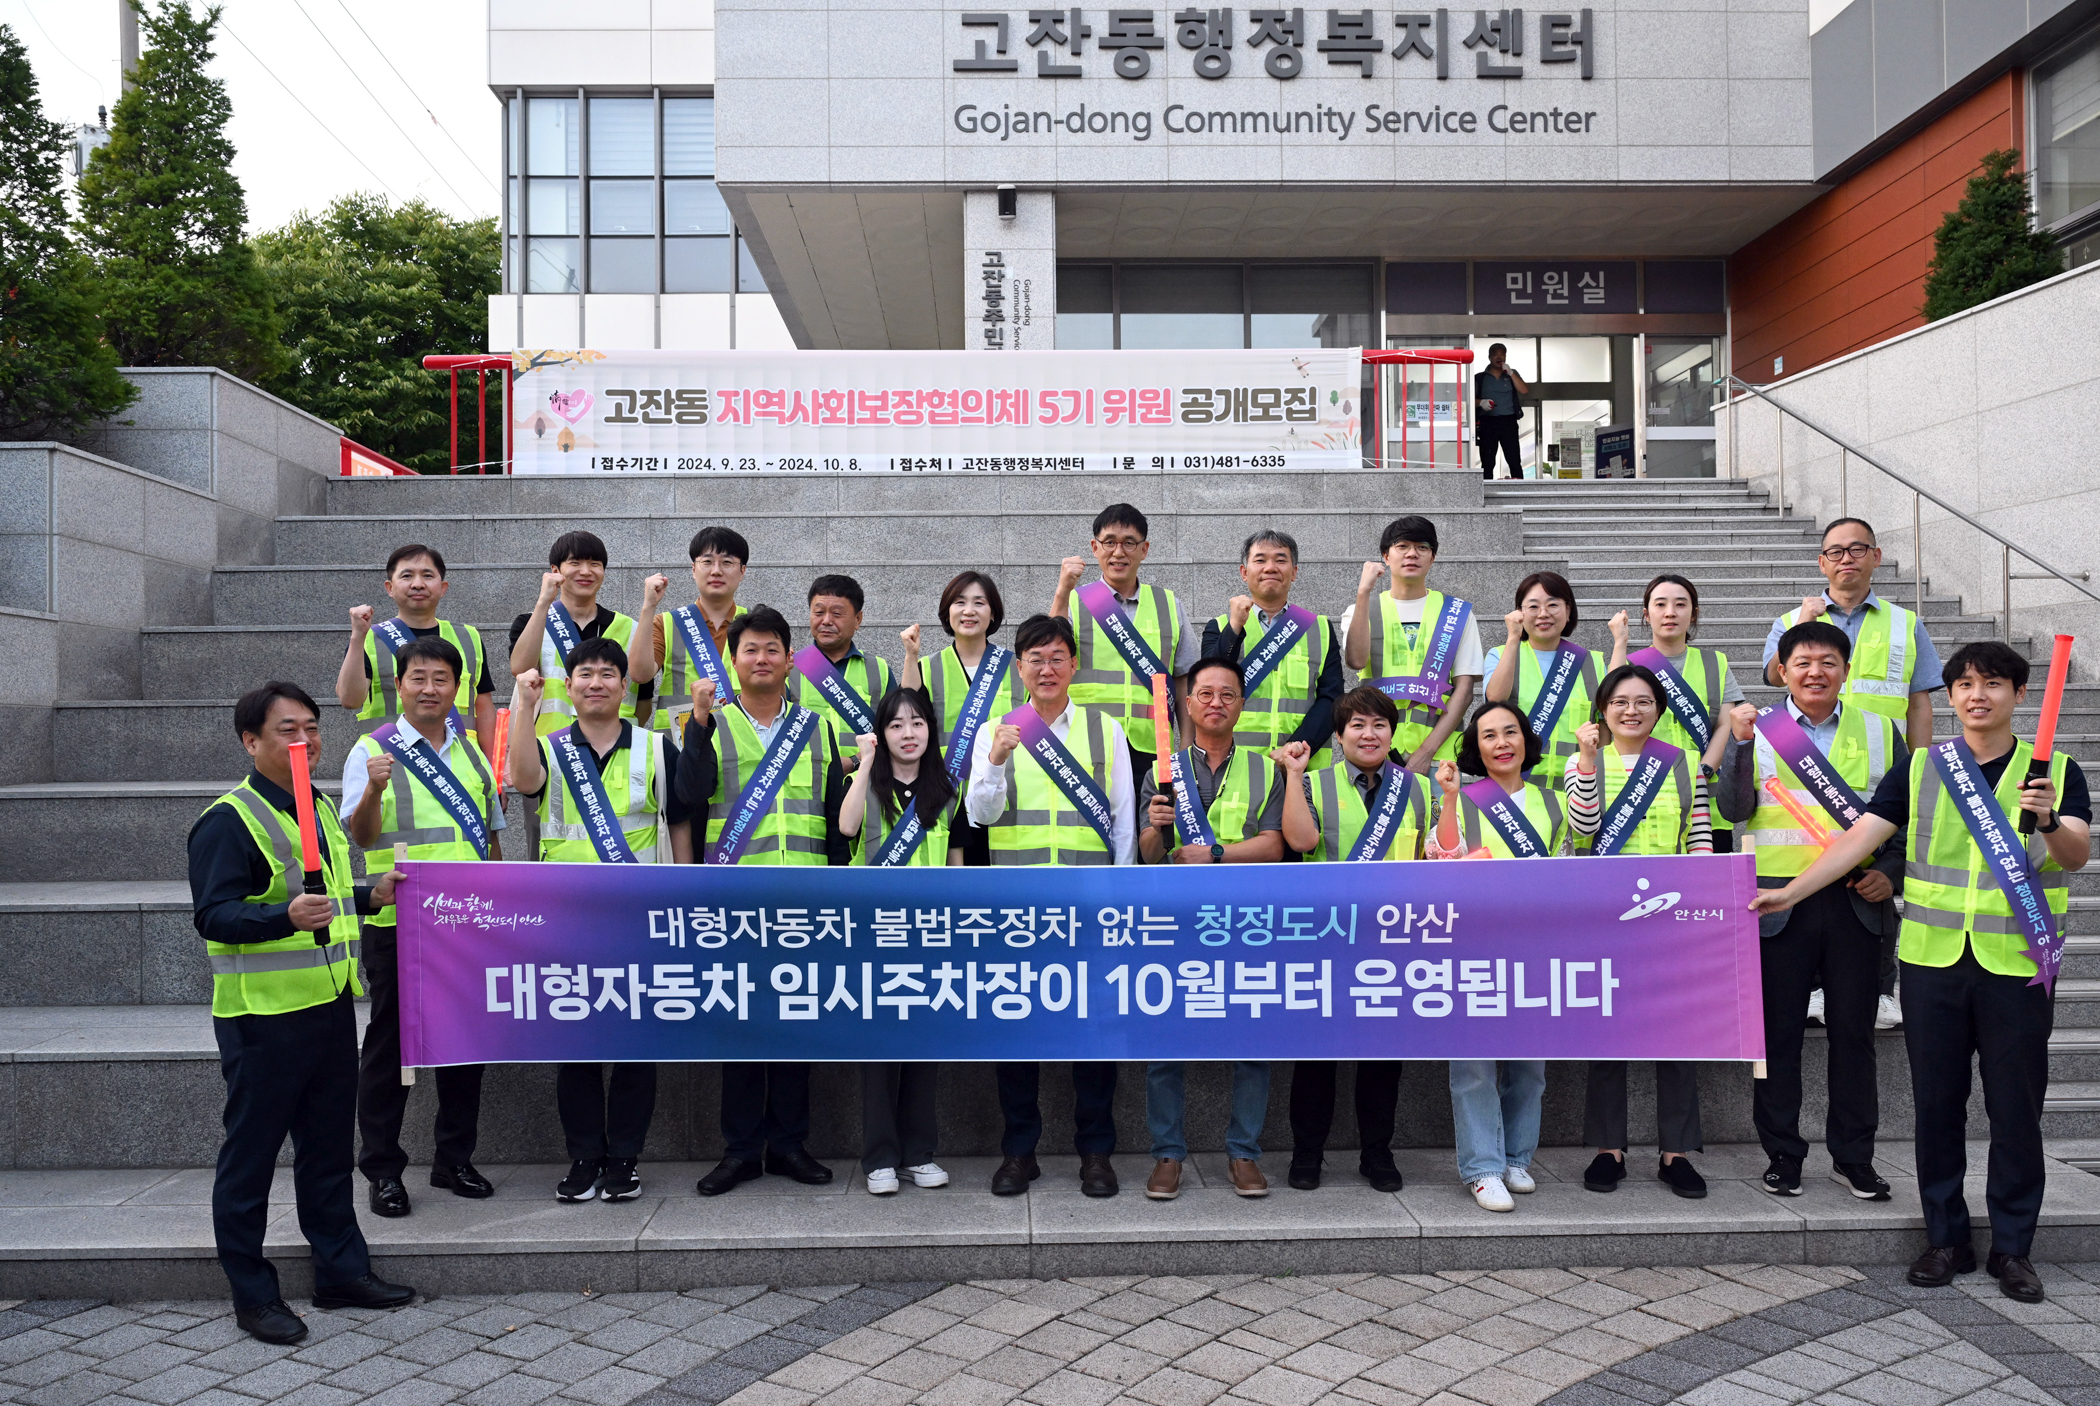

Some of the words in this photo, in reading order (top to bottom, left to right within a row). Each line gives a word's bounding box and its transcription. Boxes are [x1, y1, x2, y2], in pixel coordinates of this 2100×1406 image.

[953, 7, 1594, 82] 고잔동행정복지센터
[955, 103, 1152, 141] Gojan-dong
[1163, 103, 1356, 140] Community
[1364, 103, 1478, 134] Service
[1487, 104, 1597, 134] Center
[981, 251, 1005, 350] 고잔동주민
[1013, 279, 1021, 326] Community
[1023, 279, 1031, 327] Gojan-dong
[1505, 269, 1607, 306] 민원실
[1013, 326, 1022, 350] Servic
[603, 388, 709, 425] 고잔동
[716, 388, 1029, 425] 지역사회보장협의체
[1038, 388, 1095, 424] 5기
[1103, 388, 1172, 424] 위원
[1180, 387, 1318, 424] 공개모집
[601, 457, 659, 470] 접수기간
[678, 458, 716, 470] 2024.
[722, 459, 734, 470] 9.
[740, 459, 761, 470] 23.
[780, 459, 818, 470] 2024.
[824, 459, 844, 470] 10.
[850, 459, 862, 470] 8.
[900, 458, 942, 471] 접수처
[962, 458, 1085, 471] 고잔동행정복지센터
[1184, 455, 1286, 470] 031)481-6335
[378, 620, 408, 647] 대형자동
[548, 604, 570, 638] 형자동차
[1105, 613, 1143, 659] 대형자동차
[1259, 619, 1299, 661] 대형자동차
[1430, 632, 1452, 672] 청정도시
[1550, 650, 1576, 692] 대형자동차
[821, 675, 861, 718] 대형자동차
[968, 673, 994, 717] 불법주정차
[1427, 671, 1439, 681] 안
[1655, 669, 1696, 717] 대형자동차
[961, 717, 977, 738] 없는
[1533, 692, 1558, 735] 불법주정
[388, 733, 438, 777] 대형자동차
[433, 775, 476, 825] 불법주정차
[758, 738, 794, 789] 불법주정차
[1035, 737, 1080, 788] 대형자동차
[1627, 756, 1662, 806] 대형자동차
[1799, 755, 1848, 809] 대형자동차
[559, 735, 588, 781] 대형자동차
[579, 783, 610, 837] 불법주정차
[602, 837, 622, 862] 없는
[745, 787, 766, 811] 없는
[1381, 768, 1406, 815] 대형자동차
[723, 808, 752, 855] 청정도시
[1490, 801, 1535, 854] 대형자동차
[1595, 802, 1635, 856] 불법주정차
[1938, 742, 1976, 794] 대형자동차
[1966, 794, 2010, 855] 불법주정차
[1999, 856, 2024, 884] 없는
[2014, 882, 2047, 935] 청정도시
[648, 907, 857, 949] 대형자동차
[870, 906, 1082, 948] 불법주정차
[1097, 905, 1180, 947] 없는
[1194, 903, 1358, 947] 청정도시
[1376, 902, 1460, 944] 안산
[1674, 908, 1724, 921] 안산시
[485, 962, 756, 1021] 대형자동차
[770, 961, 1088, 1020] 임시주차장이
[1104, 959, 1333, 1018] 10월부터
[1349, 958, 1620, 1018] 운영됩니다
